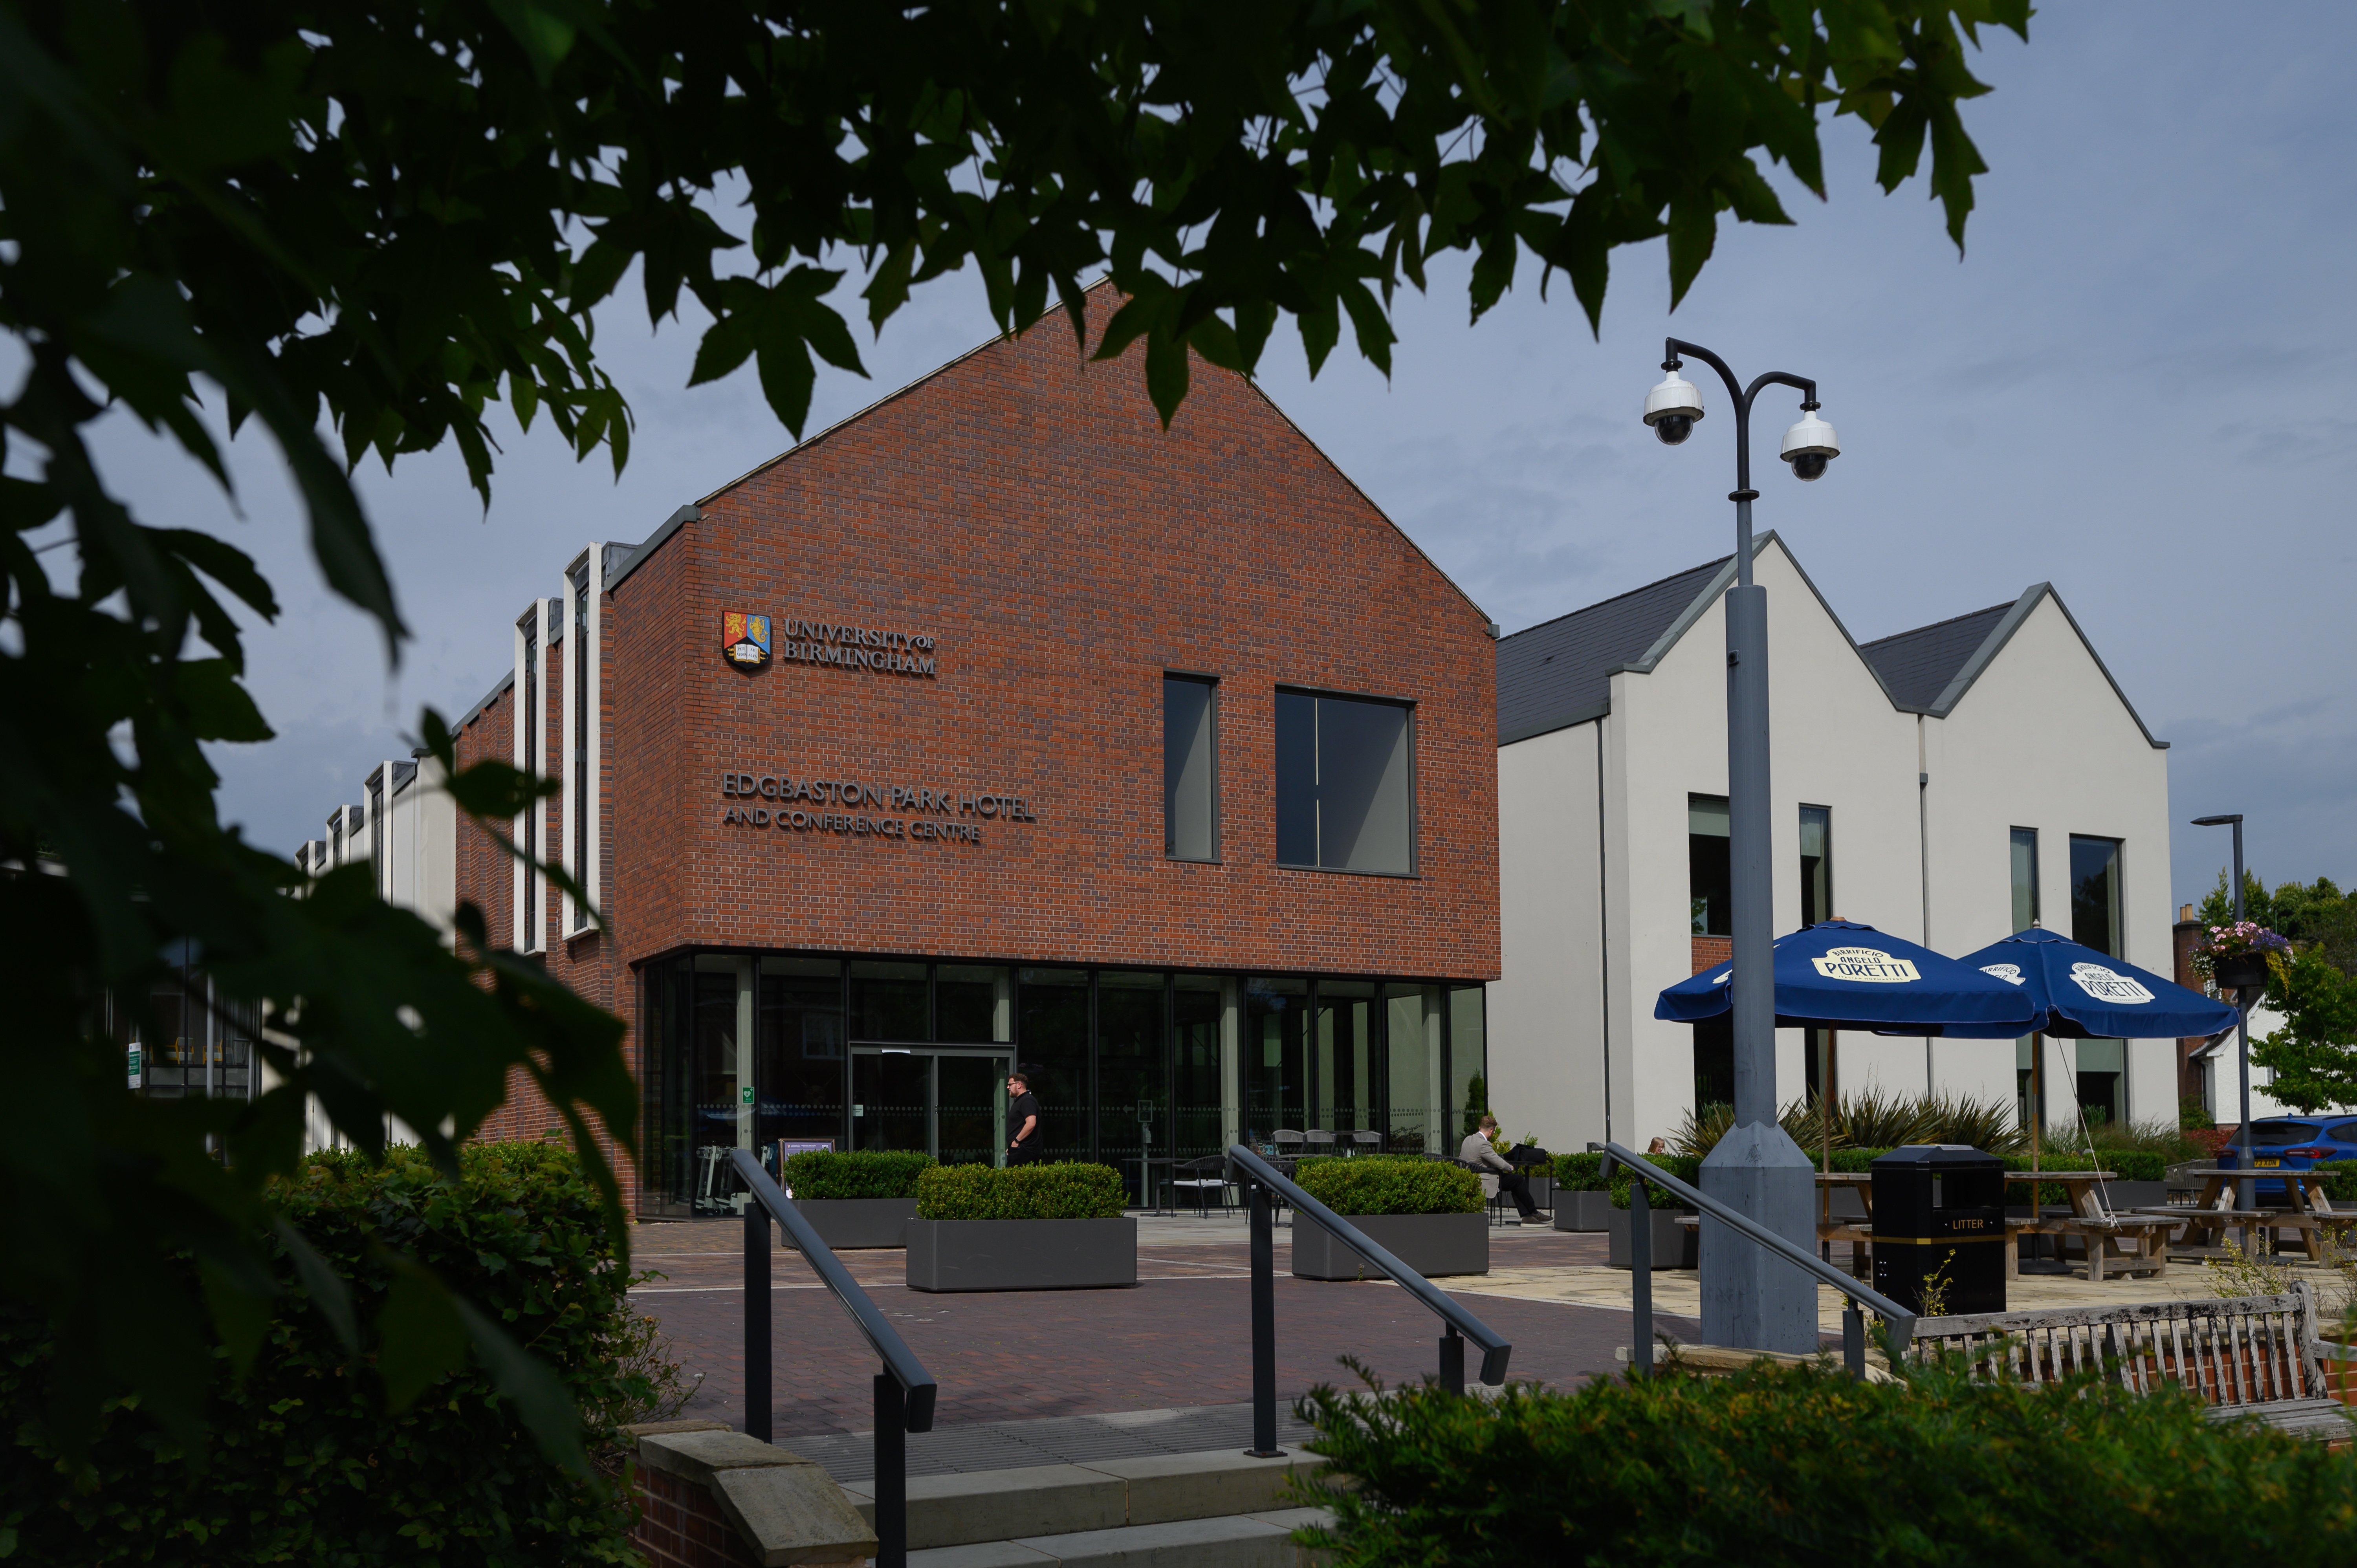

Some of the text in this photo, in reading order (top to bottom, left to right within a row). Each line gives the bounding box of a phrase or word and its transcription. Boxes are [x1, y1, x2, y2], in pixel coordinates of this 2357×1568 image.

[784, 618, 935, 650] UNIVERSITY OF
[784, 641, 936, 674] BIRMINGHAM
[723, 772, 1036, 818] EDGBASTON PARK HOTEL
[723, 806, 980, 841] AND CONFERENCE CENTRE
[1832, 949, 1884, 958] BIRRIFICIO
[1824, 962, 1909, 977] PORETTI
[1983, 966, 2017, 975] IRRIFICIO
[2085, 973, 2115, 981] ANGELO
[2080, 980, 2146, 996] PORETTI
[1953, 1219, 1983, 1229] LITTER
